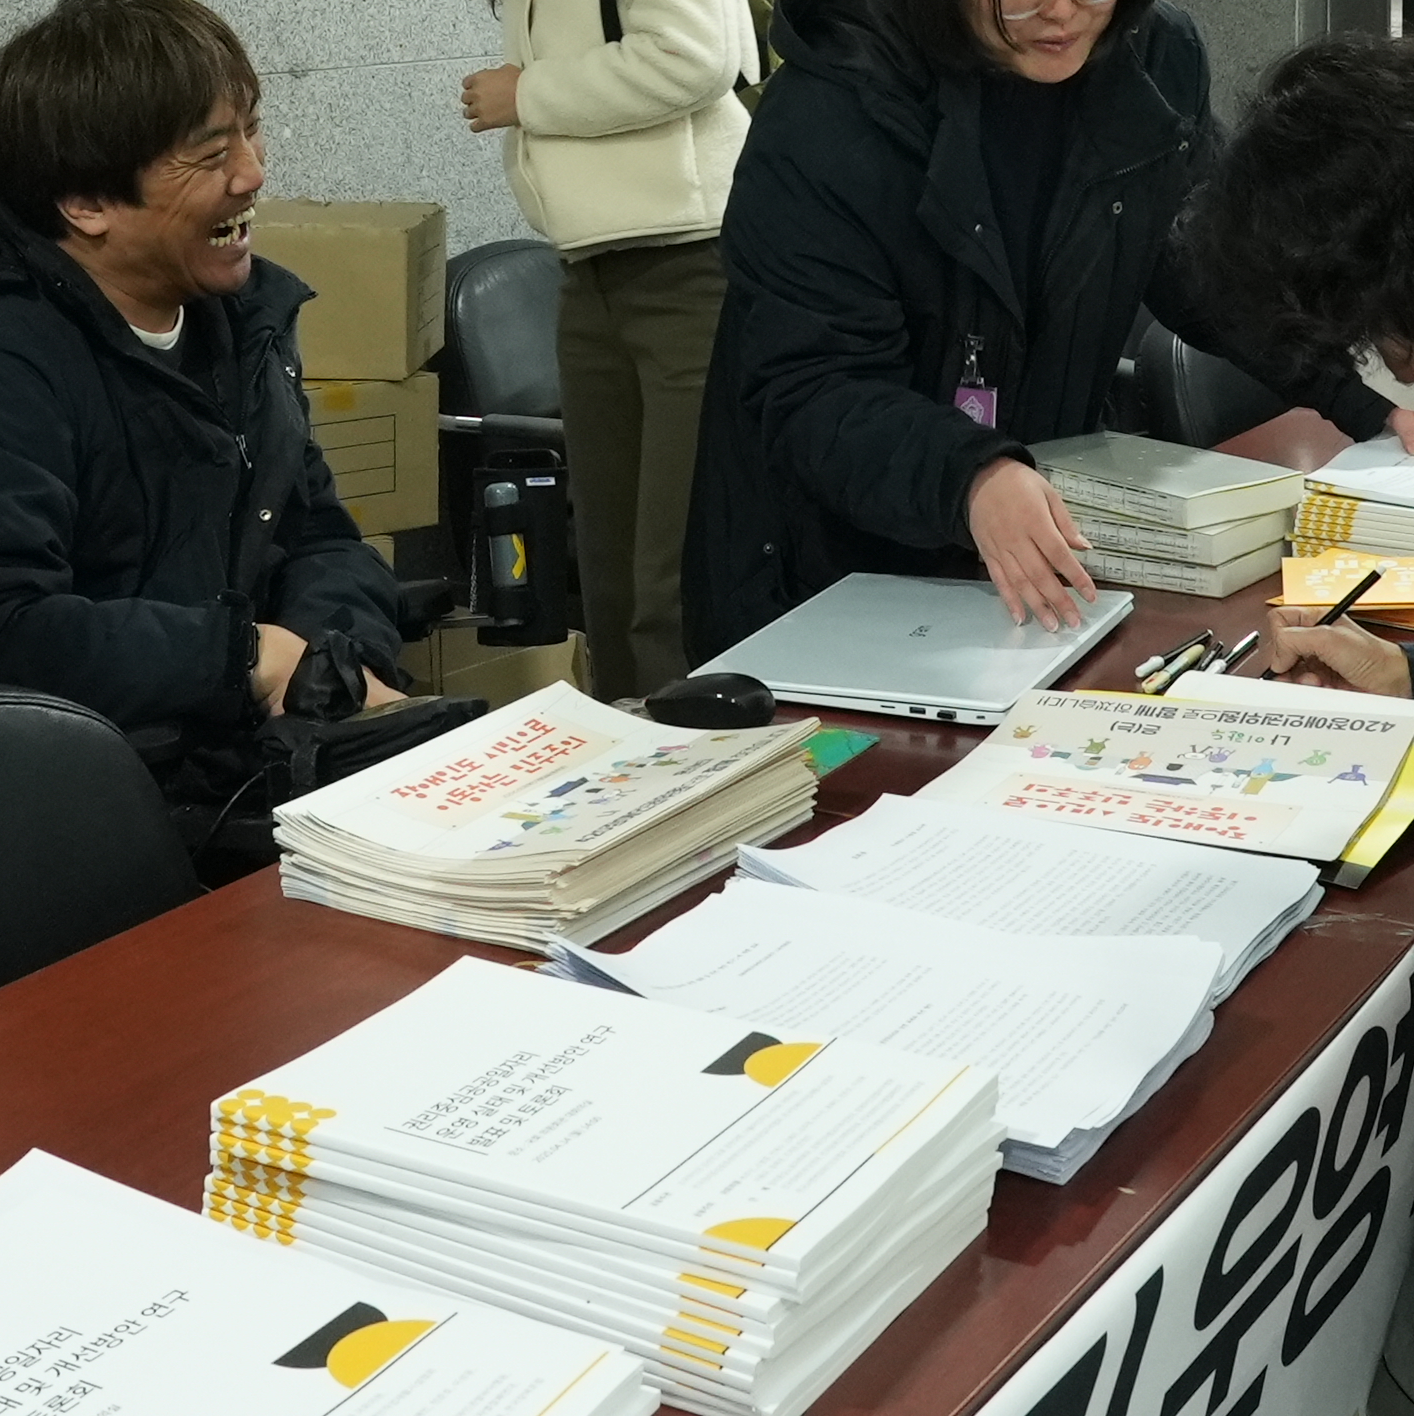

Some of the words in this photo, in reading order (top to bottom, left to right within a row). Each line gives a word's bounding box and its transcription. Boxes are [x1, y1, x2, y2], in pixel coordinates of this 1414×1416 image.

[1037, 696, 1133, 715] 하겠습니다!
[1134, 704, 1178, 721] 함께
[1110, 721, 1161, 737] 은(는)
[1182, 708, 1396, 734] 420장애인권위원으로
[1270, 734, 1292, 746] 나
[390, 758, 484, 798] 장애인도
[483, 718, 557, 759] 시민으로
[437, 773, 518, 810] 이동하는
[510, 735, 587, 773] 민주주의
[1003, 795, 1117, 816] 시민으로
[1023, 783, 1133, 806] 민주주의
[1126, 812, 1247, 840] 장애인도
[1145, 798, 1258, 831] 이동하는
[402, 1051, 540, 1131] 권리중심공공일자리
[436, 1117, 479, 1139] 운영
[471, 1095, 514, 1118] 실태
[503, 1084, 532, 1096] 및
[522, 1046, 589, 1084] 개선방안
[580, 1025, 616, 1045] 연구
[466, 1127, 510, 1147] 발표
[499, 1114, 529, 1127] 및
[518, 1085, 573, 1117] 토론회
[15, 1378, 53, 1395] 및
[45, 1319, 148, 1378] 개선방안
[141, 1289, 190, 1318] 연구
